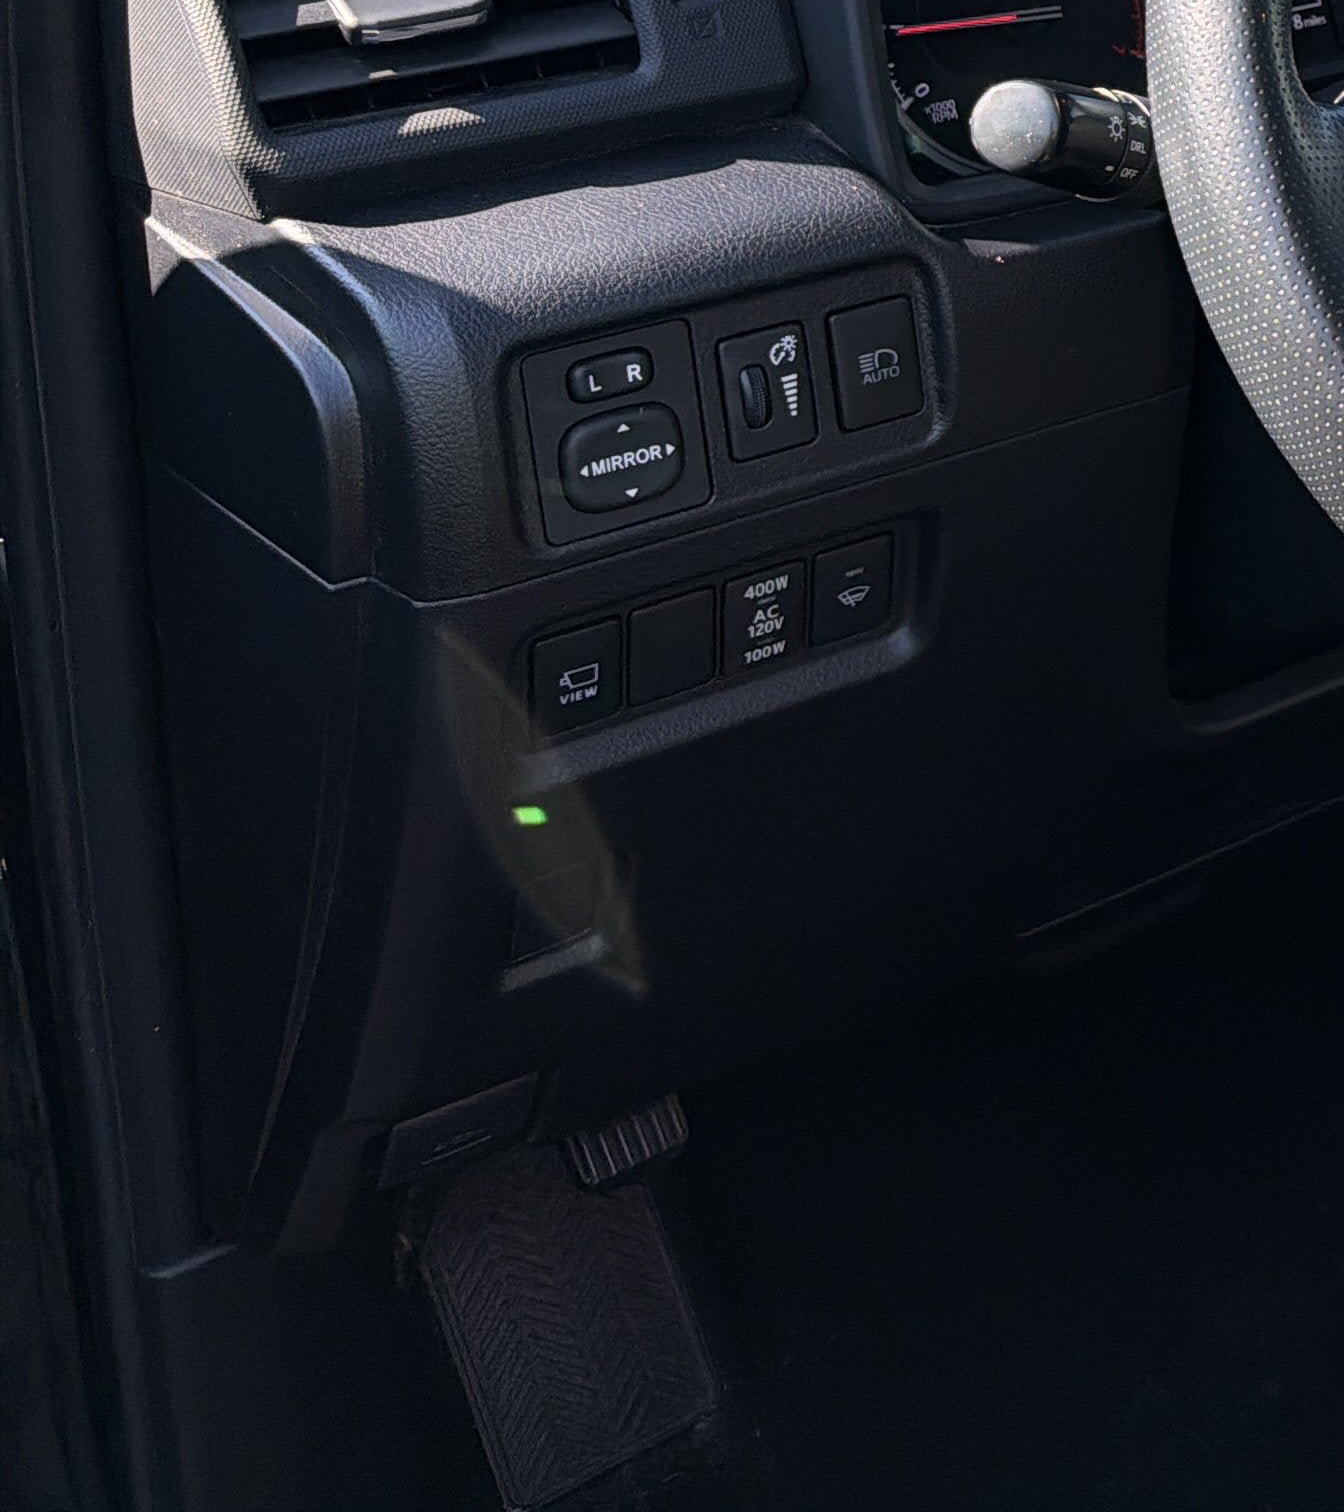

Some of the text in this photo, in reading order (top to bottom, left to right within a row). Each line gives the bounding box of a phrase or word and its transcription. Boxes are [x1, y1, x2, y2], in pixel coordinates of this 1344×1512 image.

[914, 82, 931, 98] 0
[1119, 167, 1140, 180] OFF
[588, 374, 603, 392] L
[625, 362, 645, 383] R
[863, 363, 900, 385] AUTO
[590, 443, 664, 478] MIRROR
[743, 573, 789, 600] 400W
[747, 615, 785, 638] 120V
[743, 639, 787, 665] 100W
[558, 685, 598, 706] VIEW
